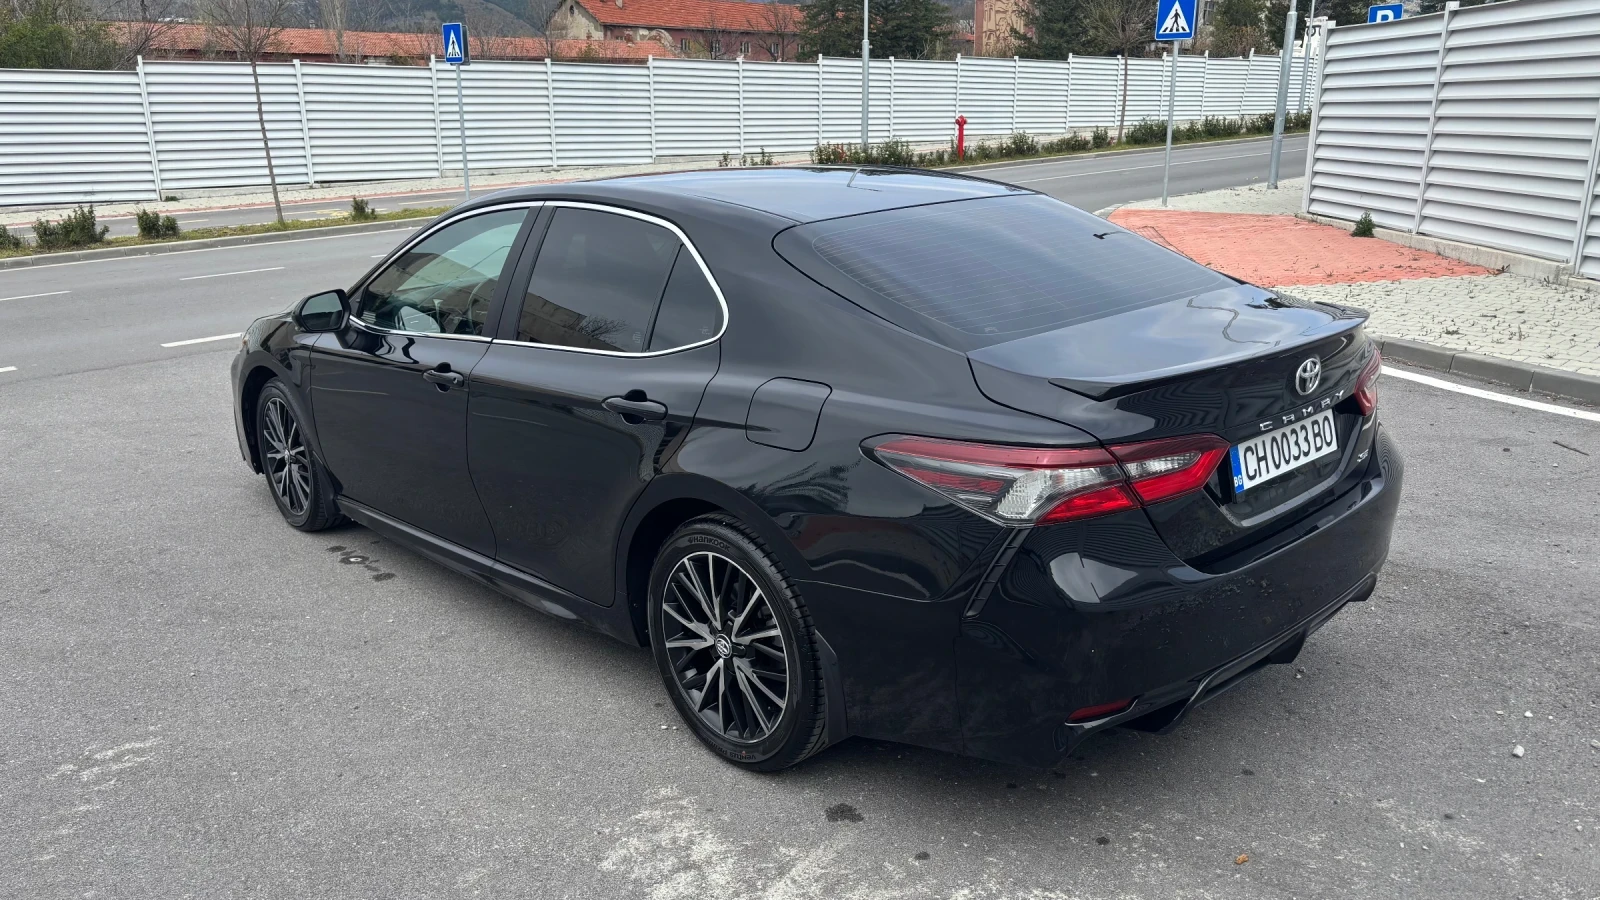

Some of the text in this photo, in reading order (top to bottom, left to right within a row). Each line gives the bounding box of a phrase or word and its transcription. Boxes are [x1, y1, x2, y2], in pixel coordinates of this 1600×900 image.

[1260, 390, 1344, 431] CAMRY
[1243, 415, 1334, 481] CH 0033 BO
[1233, 474, 1243, 488] BG
